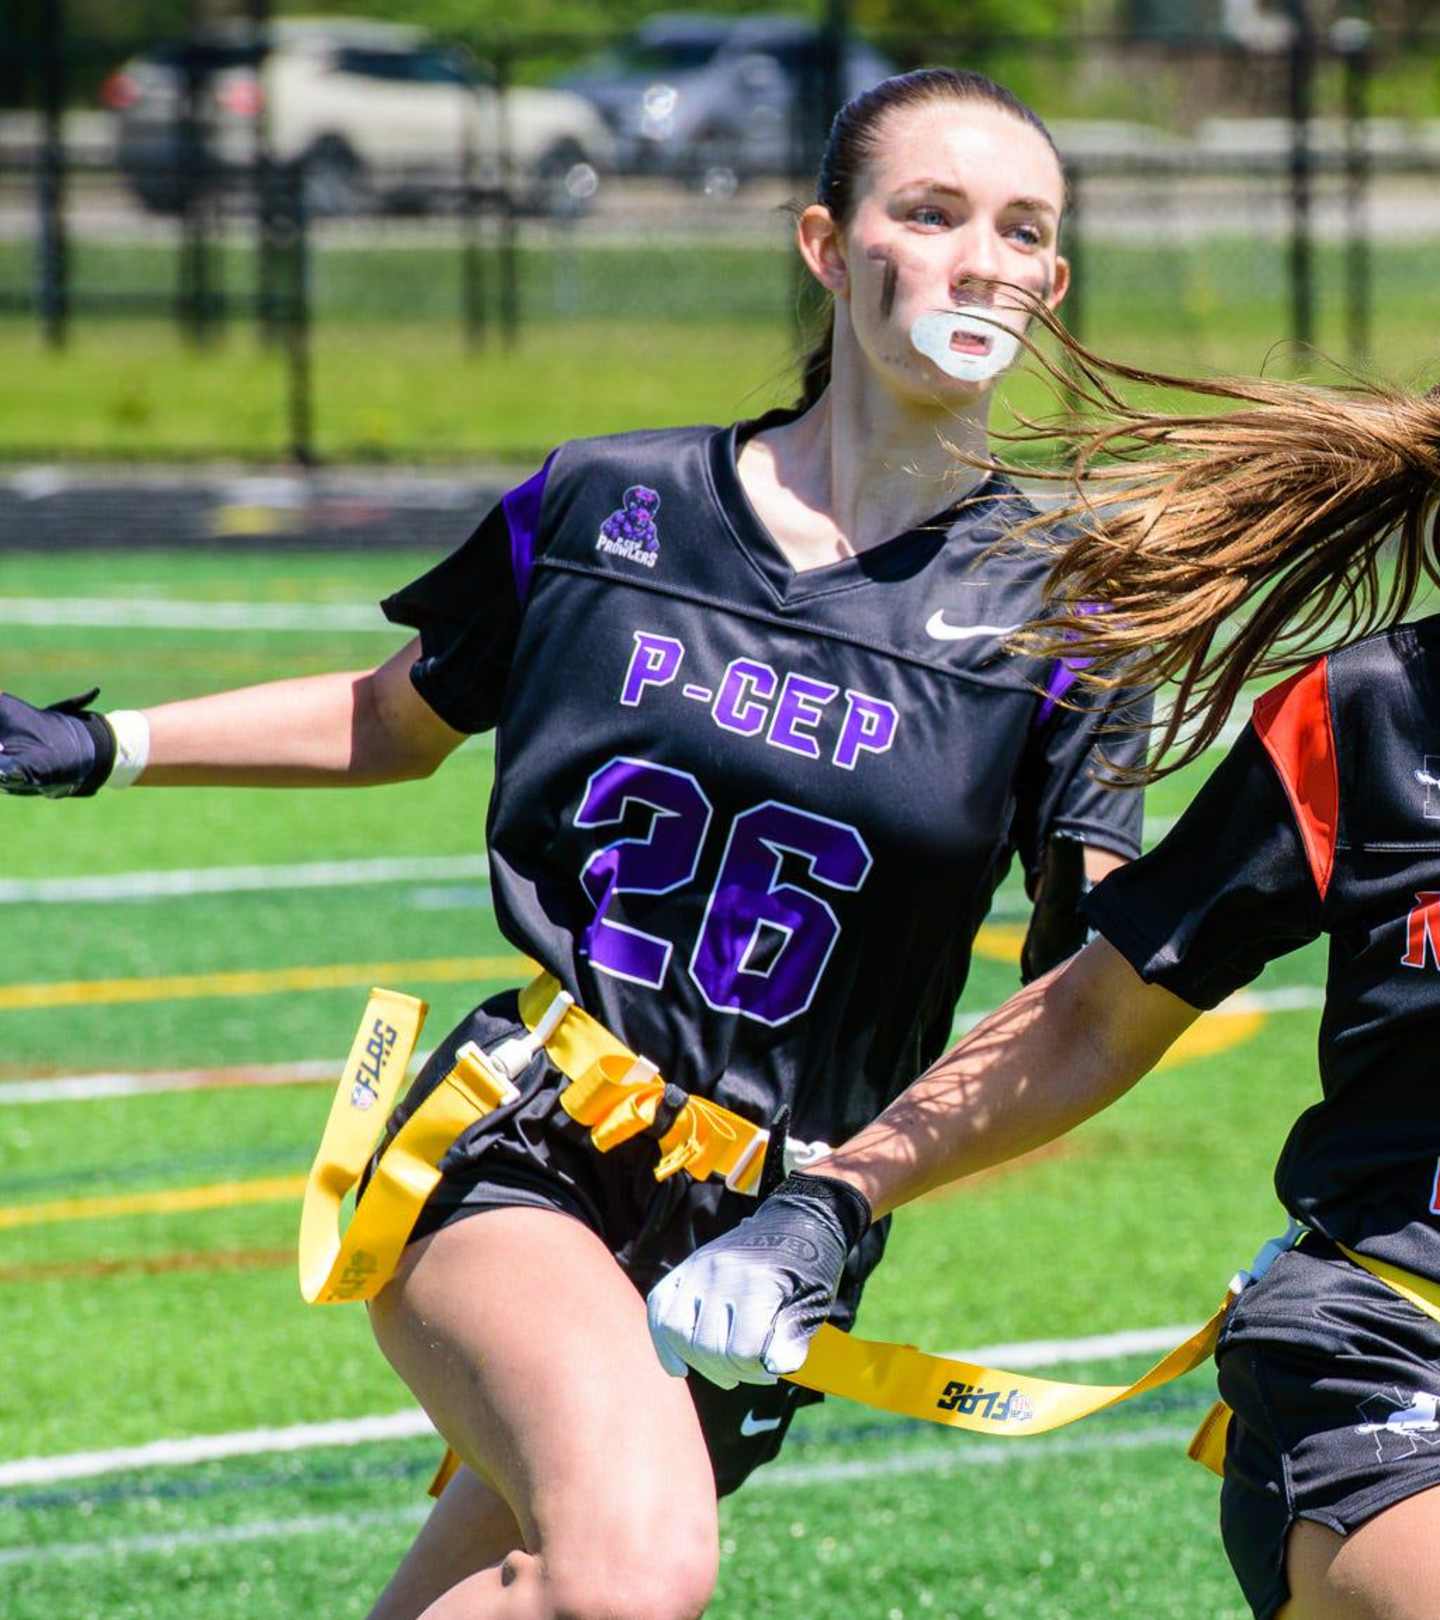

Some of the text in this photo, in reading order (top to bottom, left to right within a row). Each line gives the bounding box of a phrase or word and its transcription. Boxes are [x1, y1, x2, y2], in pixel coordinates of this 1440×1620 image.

[595, 534, 658, 568] PROWLERS
[619, 630, 900, 770] P-CEP
[573, 756, 874, 1028] 26
